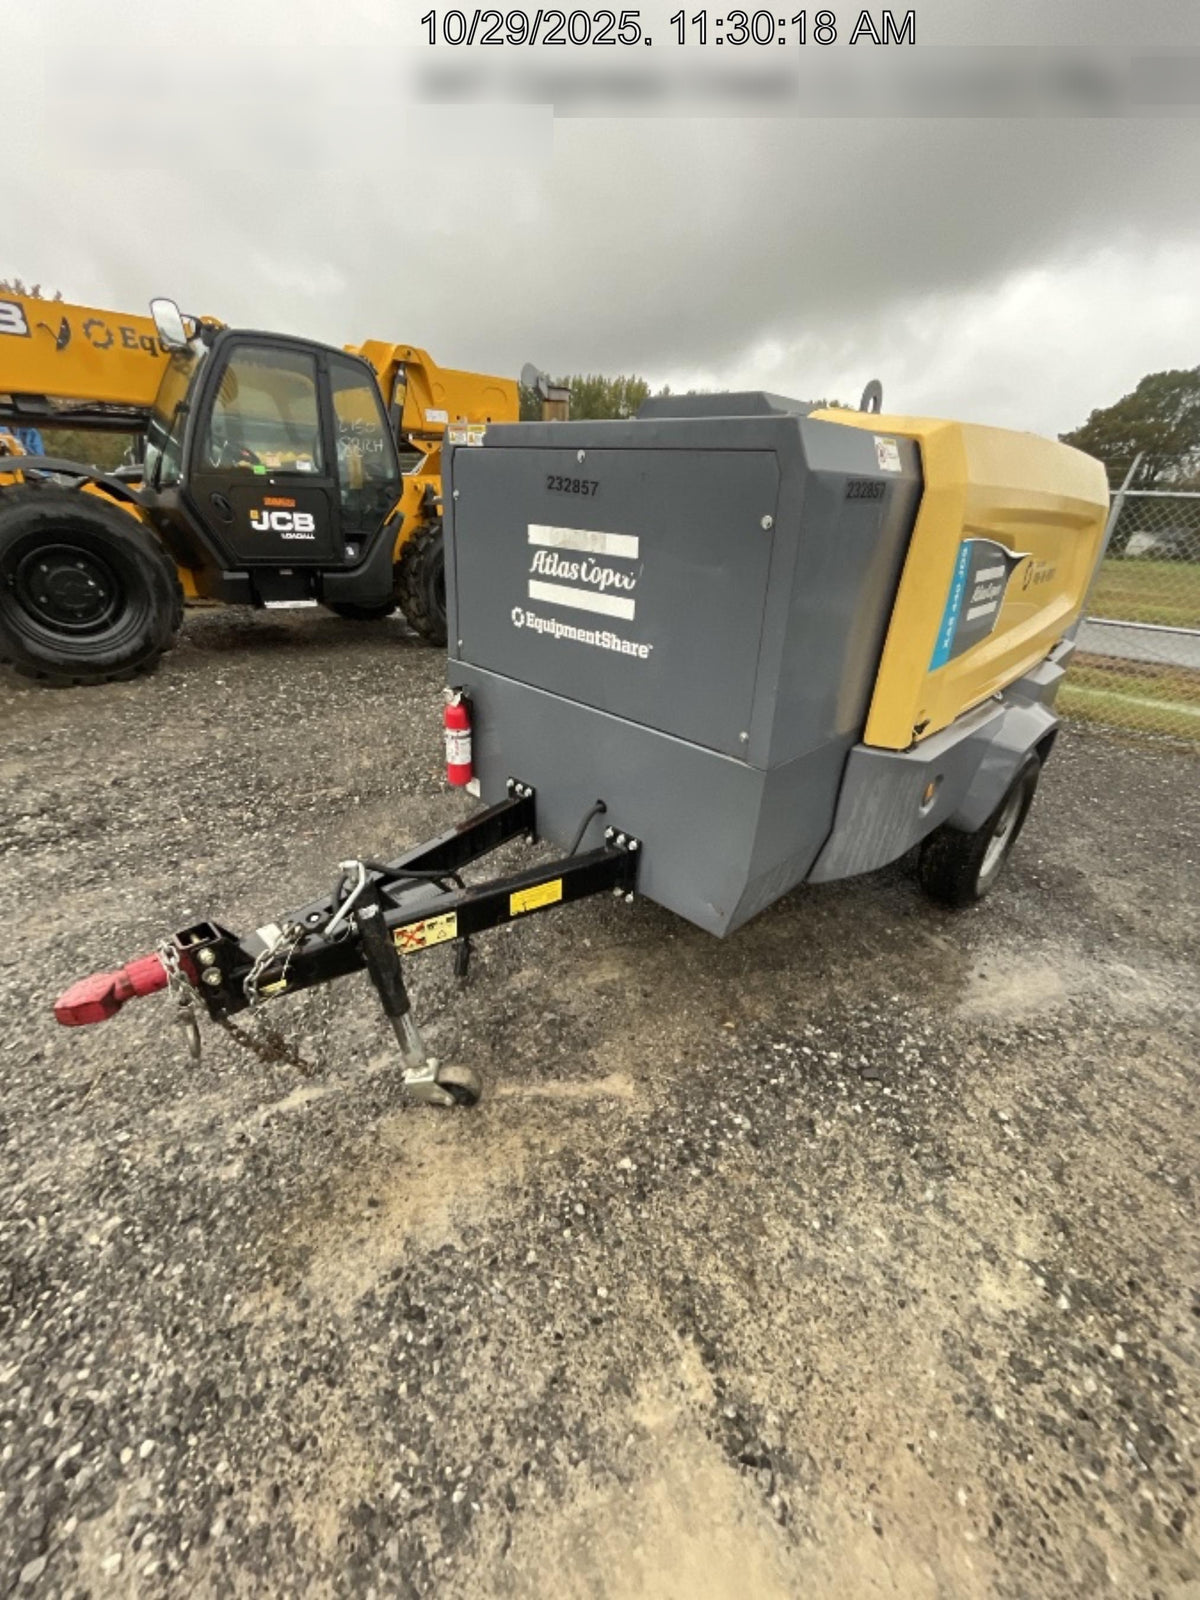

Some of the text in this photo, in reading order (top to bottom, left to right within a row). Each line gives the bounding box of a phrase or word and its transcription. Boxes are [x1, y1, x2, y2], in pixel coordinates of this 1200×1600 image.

[547, 475, 600, 497] 232857
[847, 480, 887, 499] 232857
[250, 510, 315, 532] JCB
[529, 550, 580, 580] Atlas
